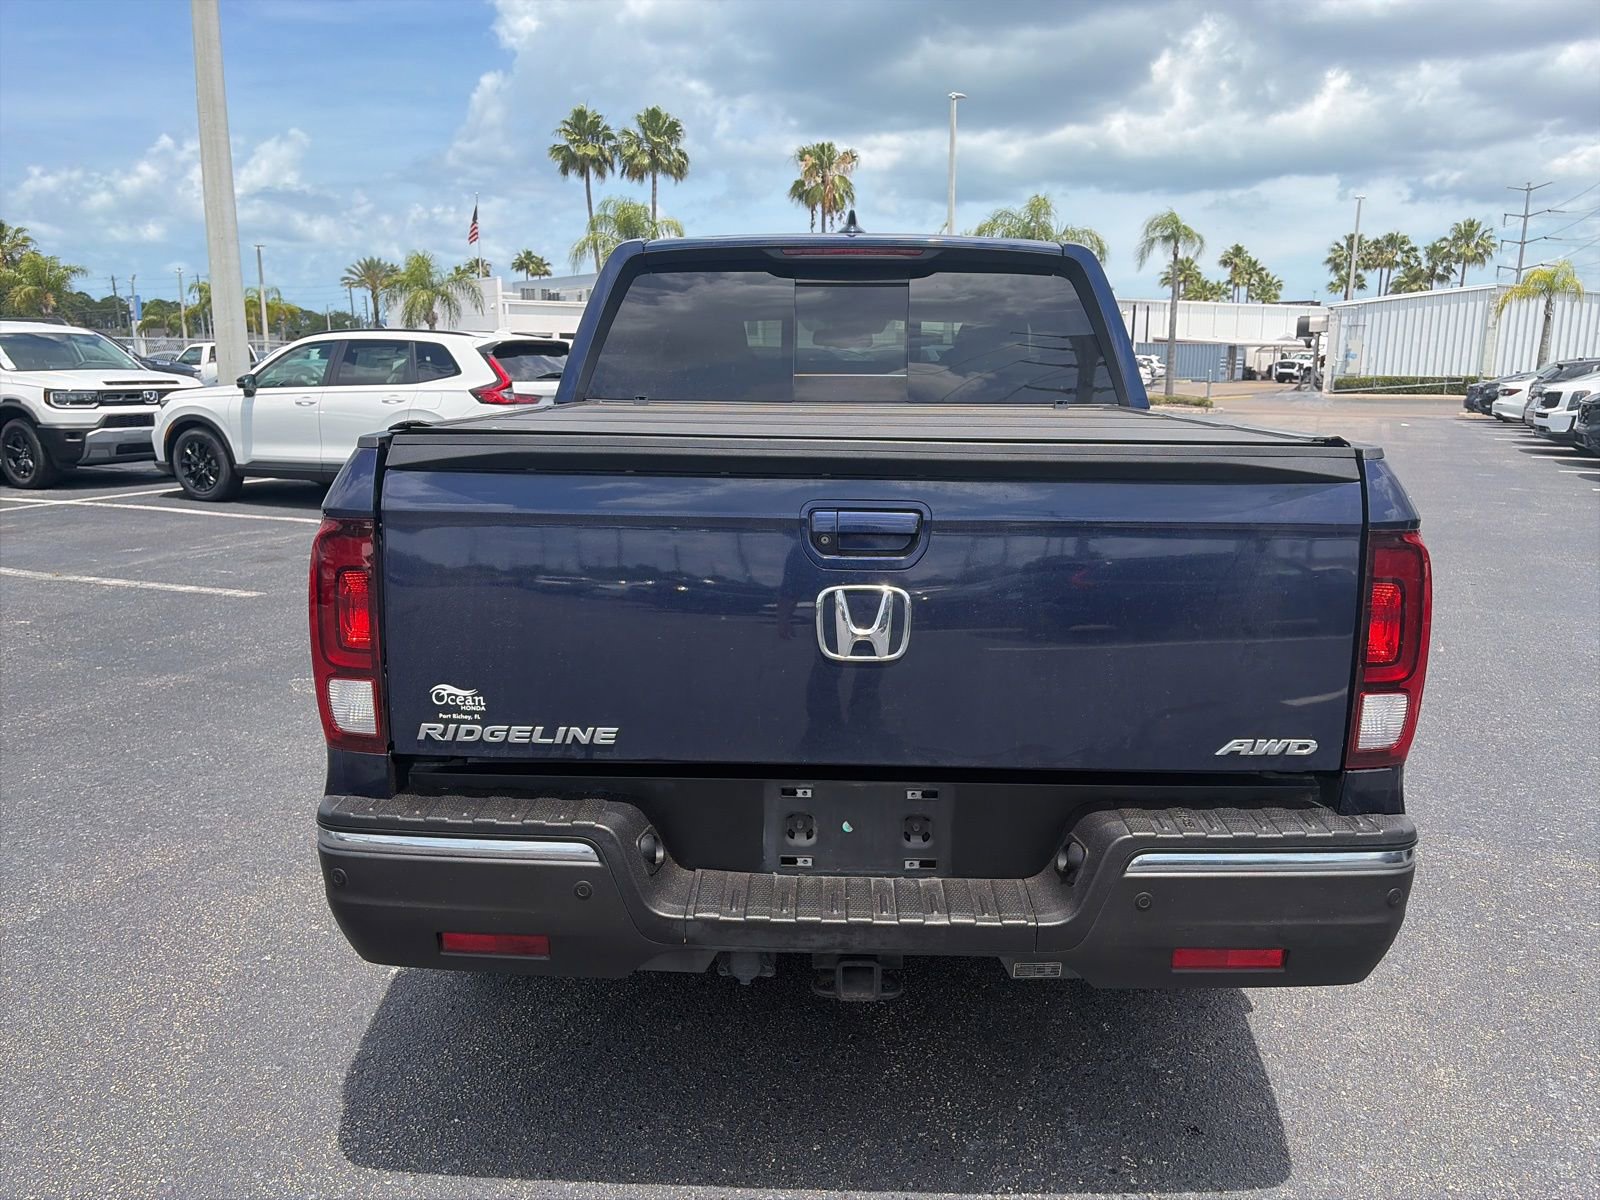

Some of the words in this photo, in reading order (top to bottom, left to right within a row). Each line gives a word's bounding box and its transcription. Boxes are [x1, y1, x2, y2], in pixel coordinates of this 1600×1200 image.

[432, 690, 486, 705] Ocean
[417, 723, 619, 744] RIDGELINE
[1214, 739, 1318, 756] AWD
